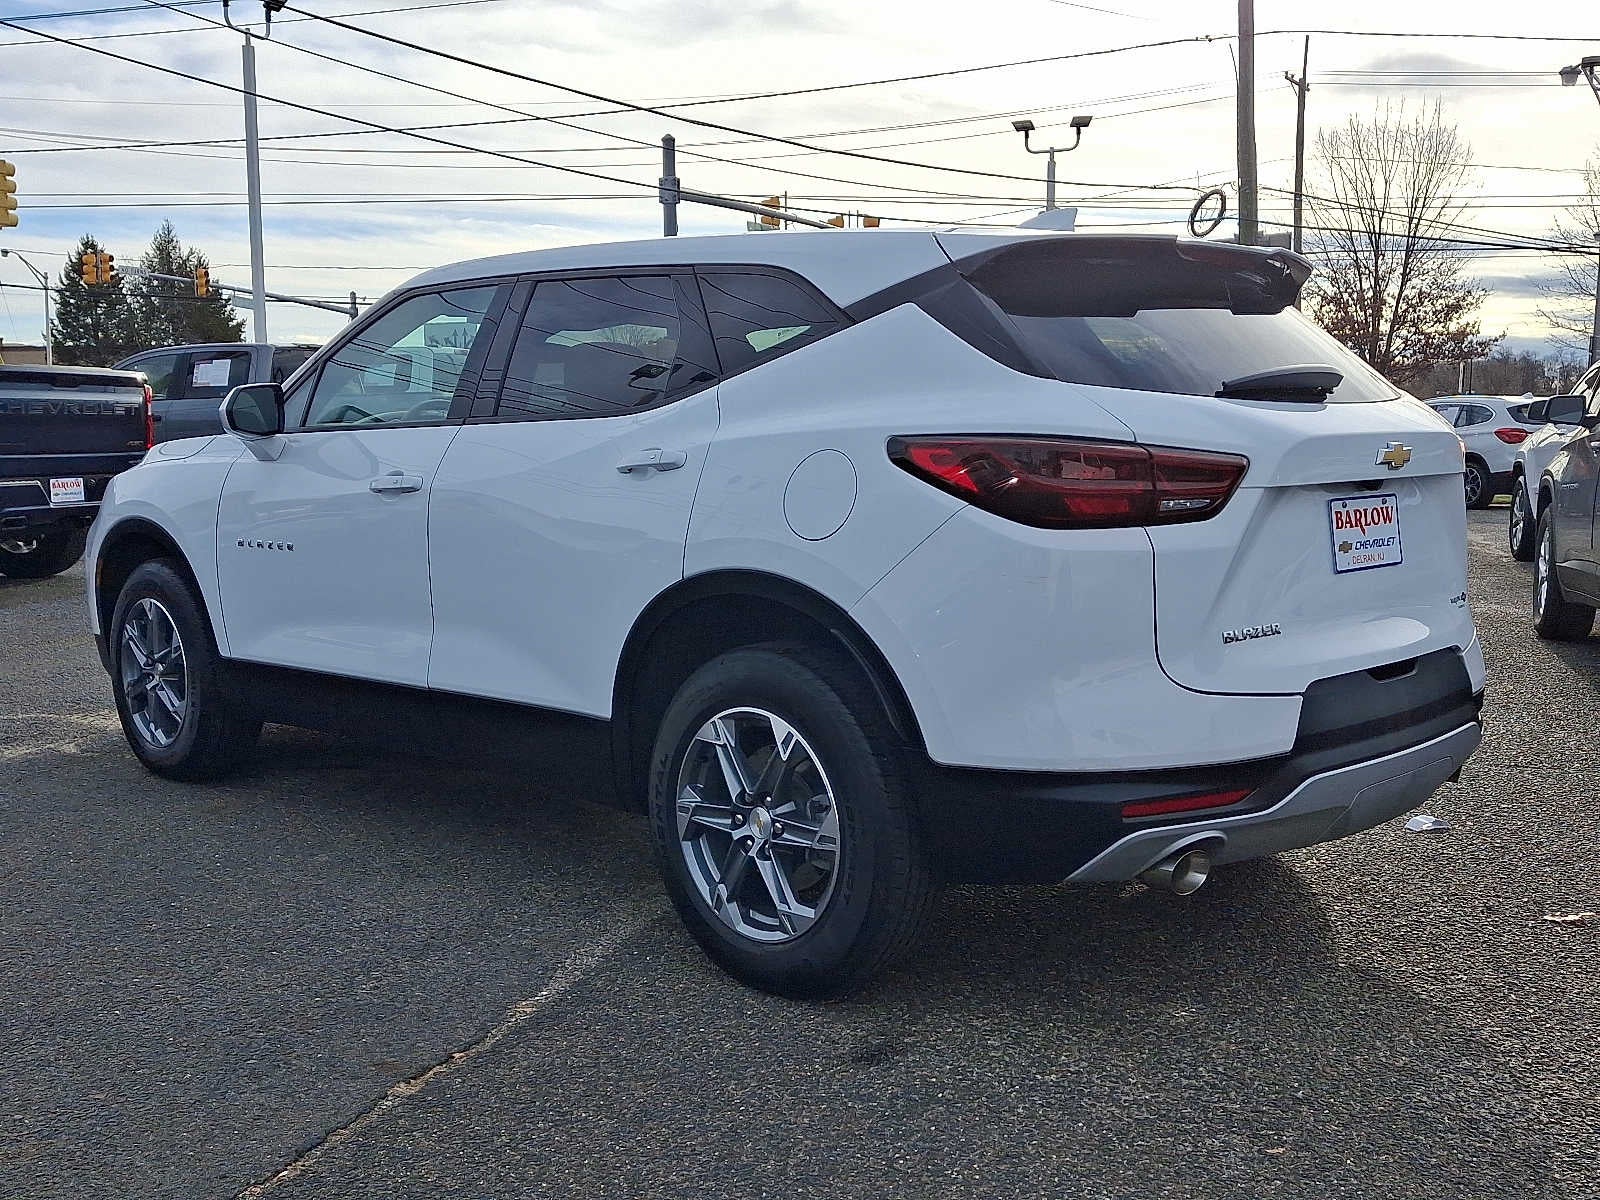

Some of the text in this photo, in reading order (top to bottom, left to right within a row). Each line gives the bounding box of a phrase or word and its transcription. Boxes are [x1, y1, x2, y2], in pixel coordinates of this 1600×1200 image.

[0, 401, 139, 416] HEVROLET
[52, 481, 82, 491] BARLOW
[1334, 505, 1394, 537] BARLOW
[237, 538, 294, 552] BLAZER
[1355, 536, 1396, 550] CHEVROLET
[1377, 551, 1385, 561] NJ
[1221, 622, 1281, 644] BLAZER
